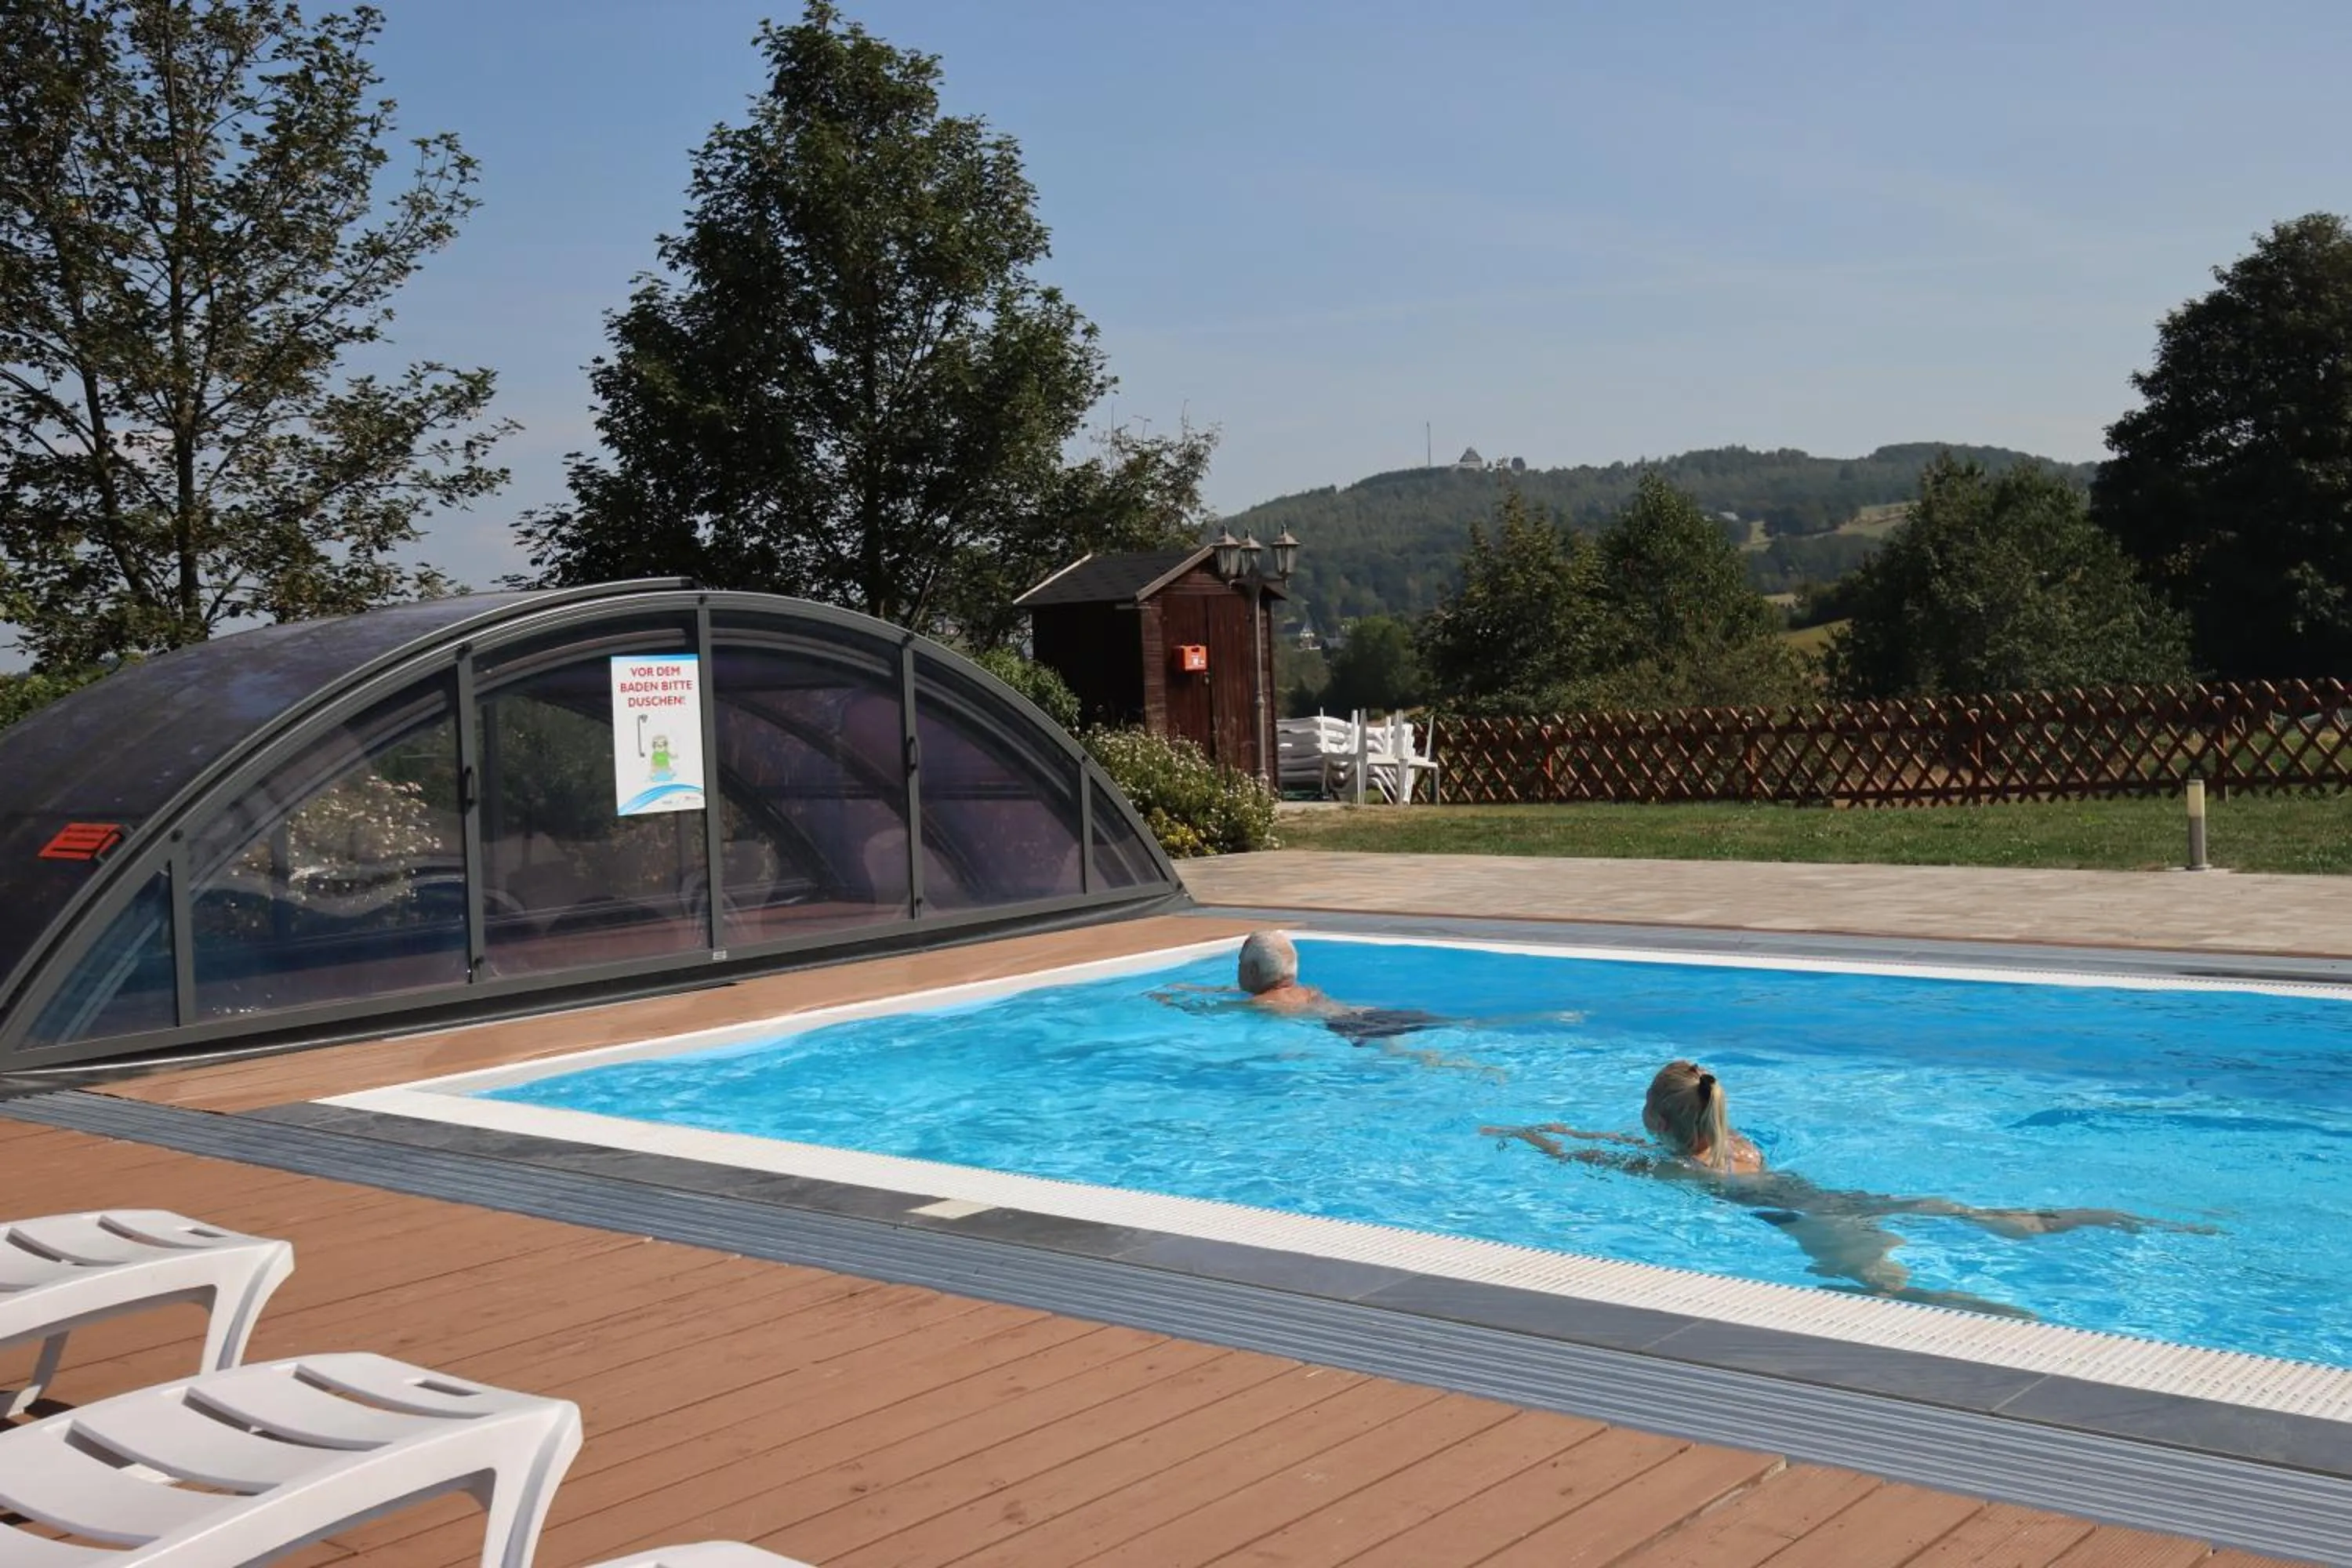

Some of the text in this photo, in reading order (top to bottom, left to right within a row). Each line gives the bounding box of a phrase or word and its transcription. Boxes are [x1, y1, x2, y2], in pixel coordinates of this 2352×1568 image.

[630, 666, 681, 677] VOR DEM
[620, 680, 693, 692] BADEN BITTE
